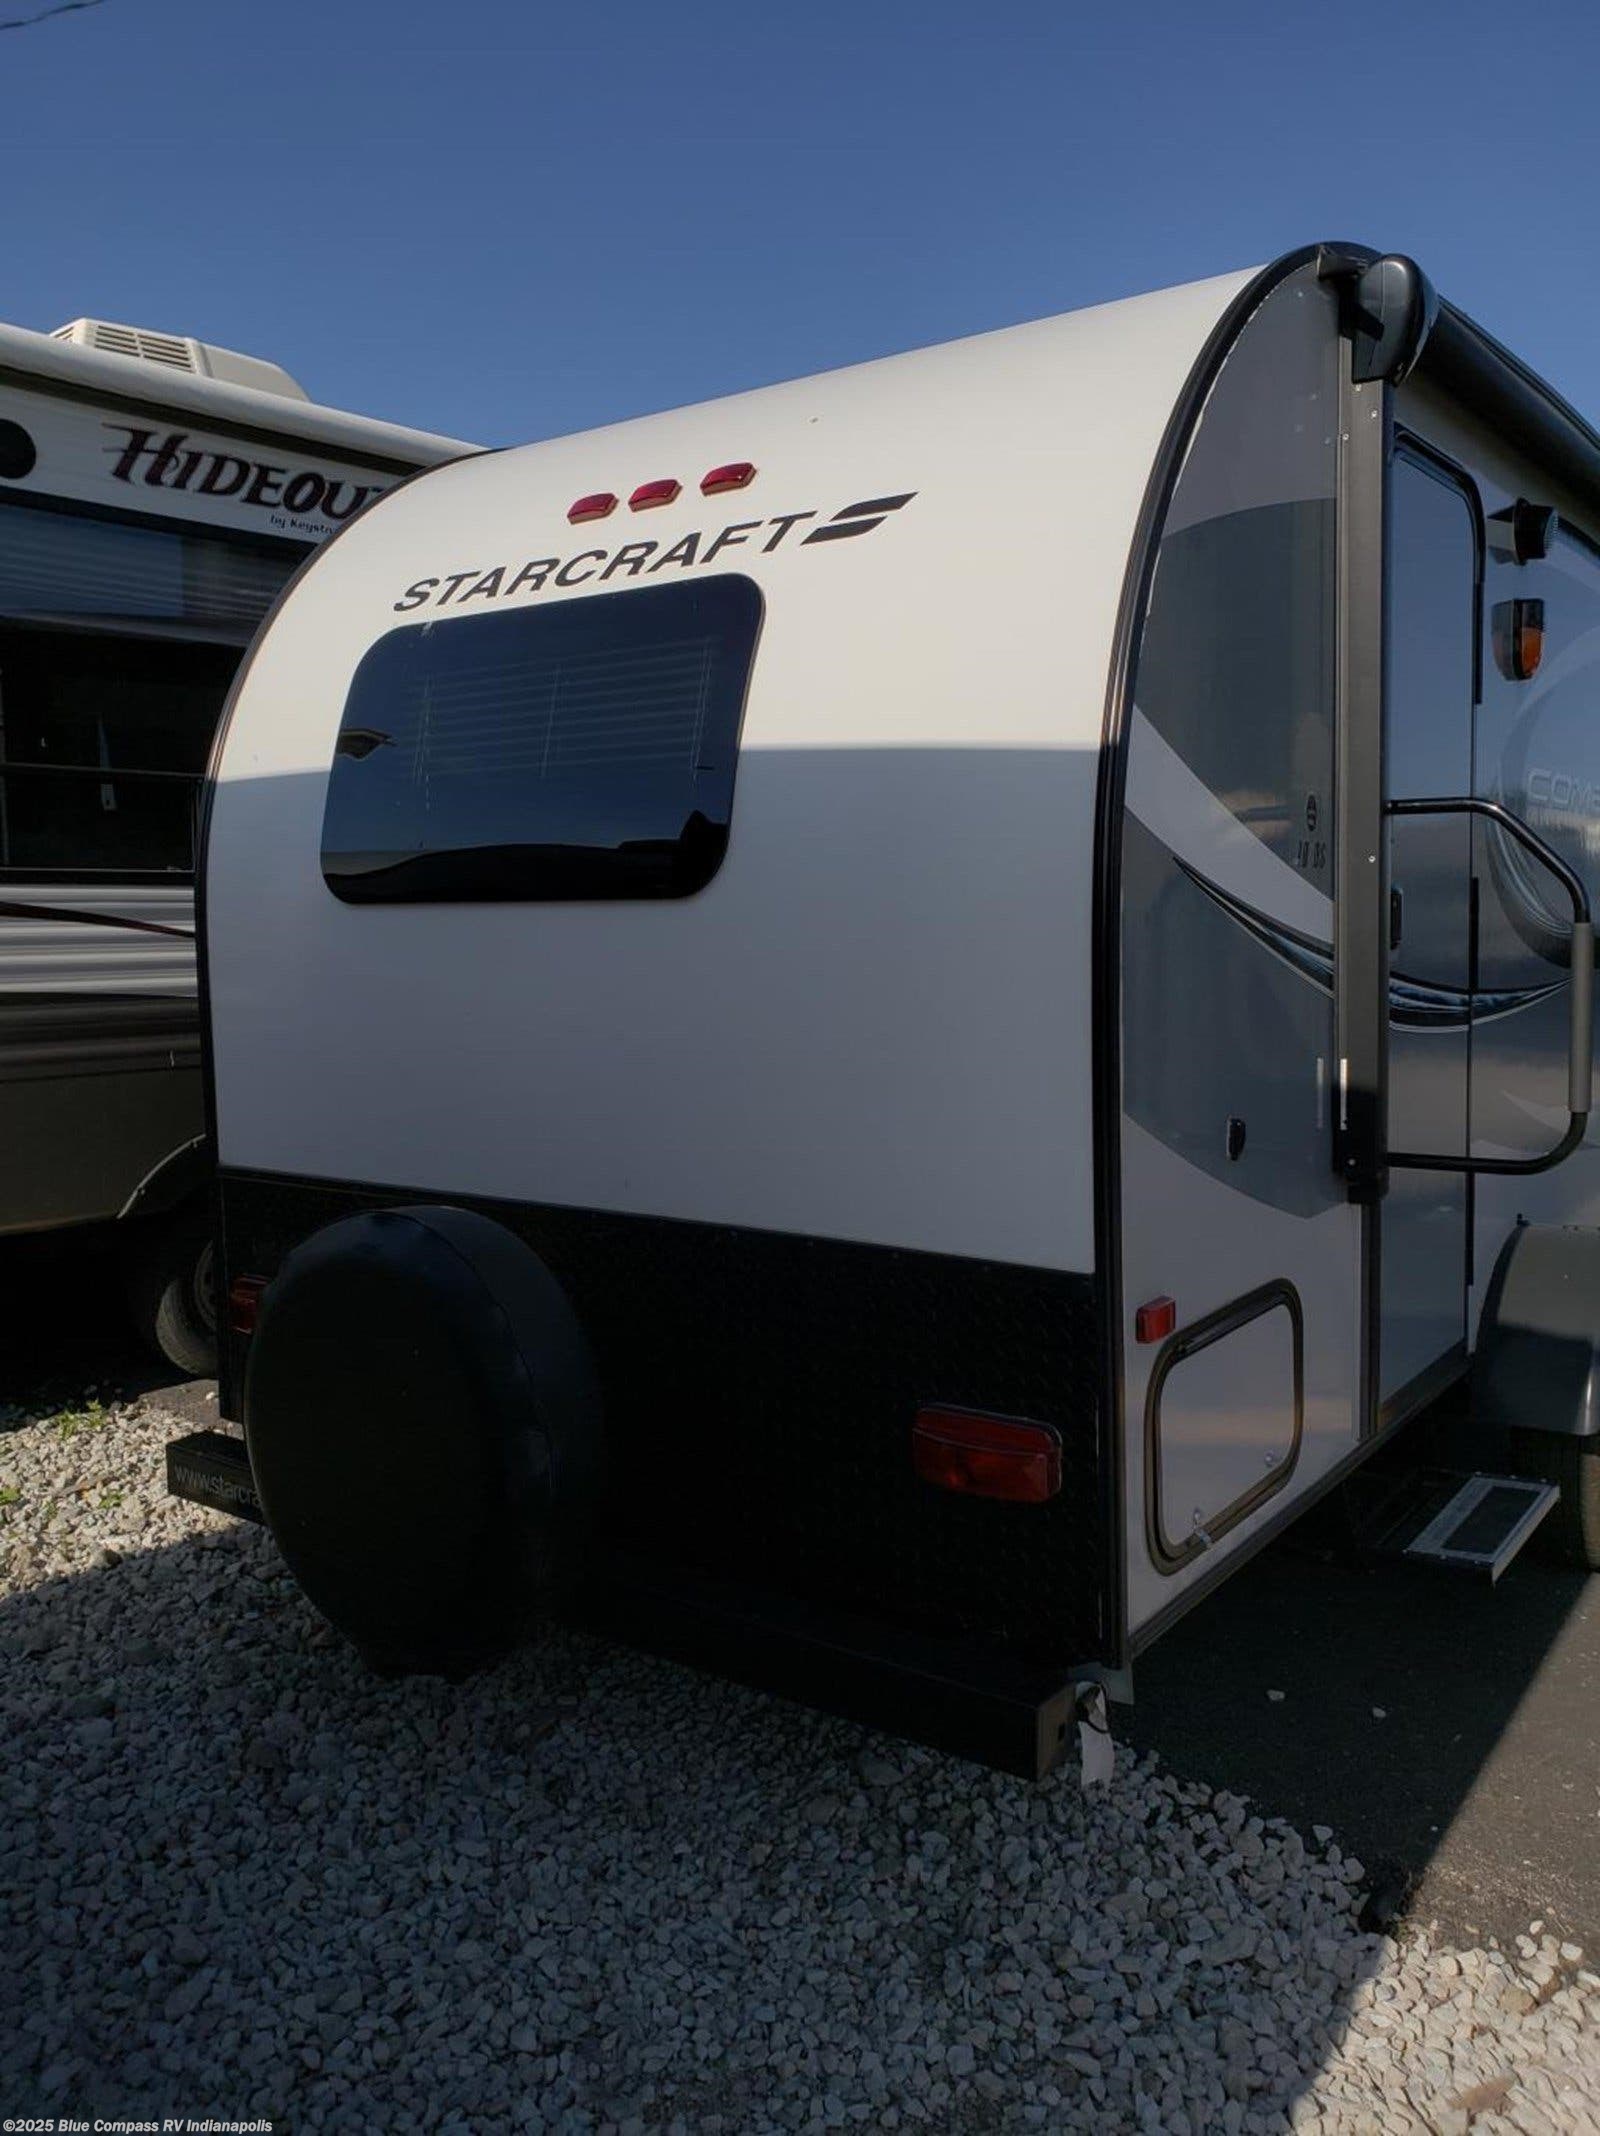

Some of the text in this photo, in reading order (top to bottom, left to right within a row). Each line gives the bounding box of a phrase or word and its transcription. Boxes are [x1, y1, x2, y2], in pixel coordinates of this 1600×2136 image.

[102, 422, 382, 521] HIDEOU
[270, 514, 286, 529] by
[393, 510, 818, 612] STARCRAFT
